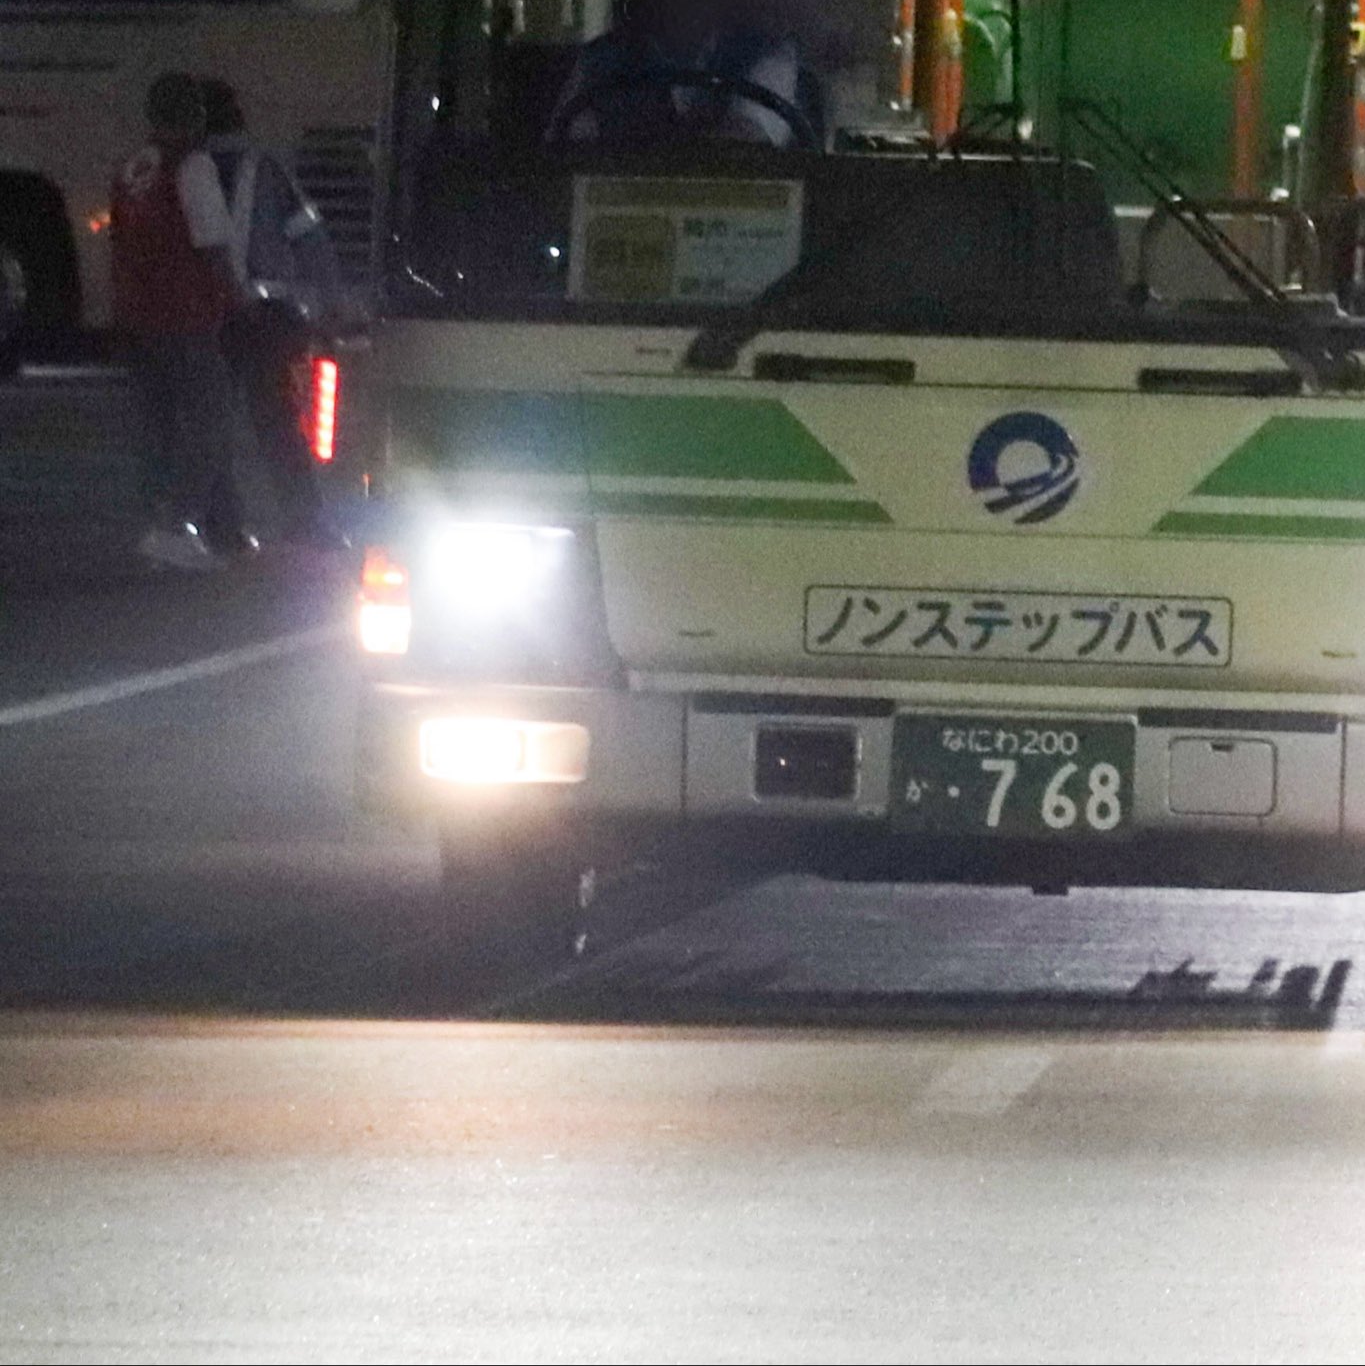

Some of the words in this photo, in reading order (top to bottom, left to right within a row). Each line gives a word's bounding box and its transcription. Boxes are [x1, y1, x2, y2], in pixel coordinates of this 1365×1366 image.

[816, 596, 1220, 658] ノンステップバス
